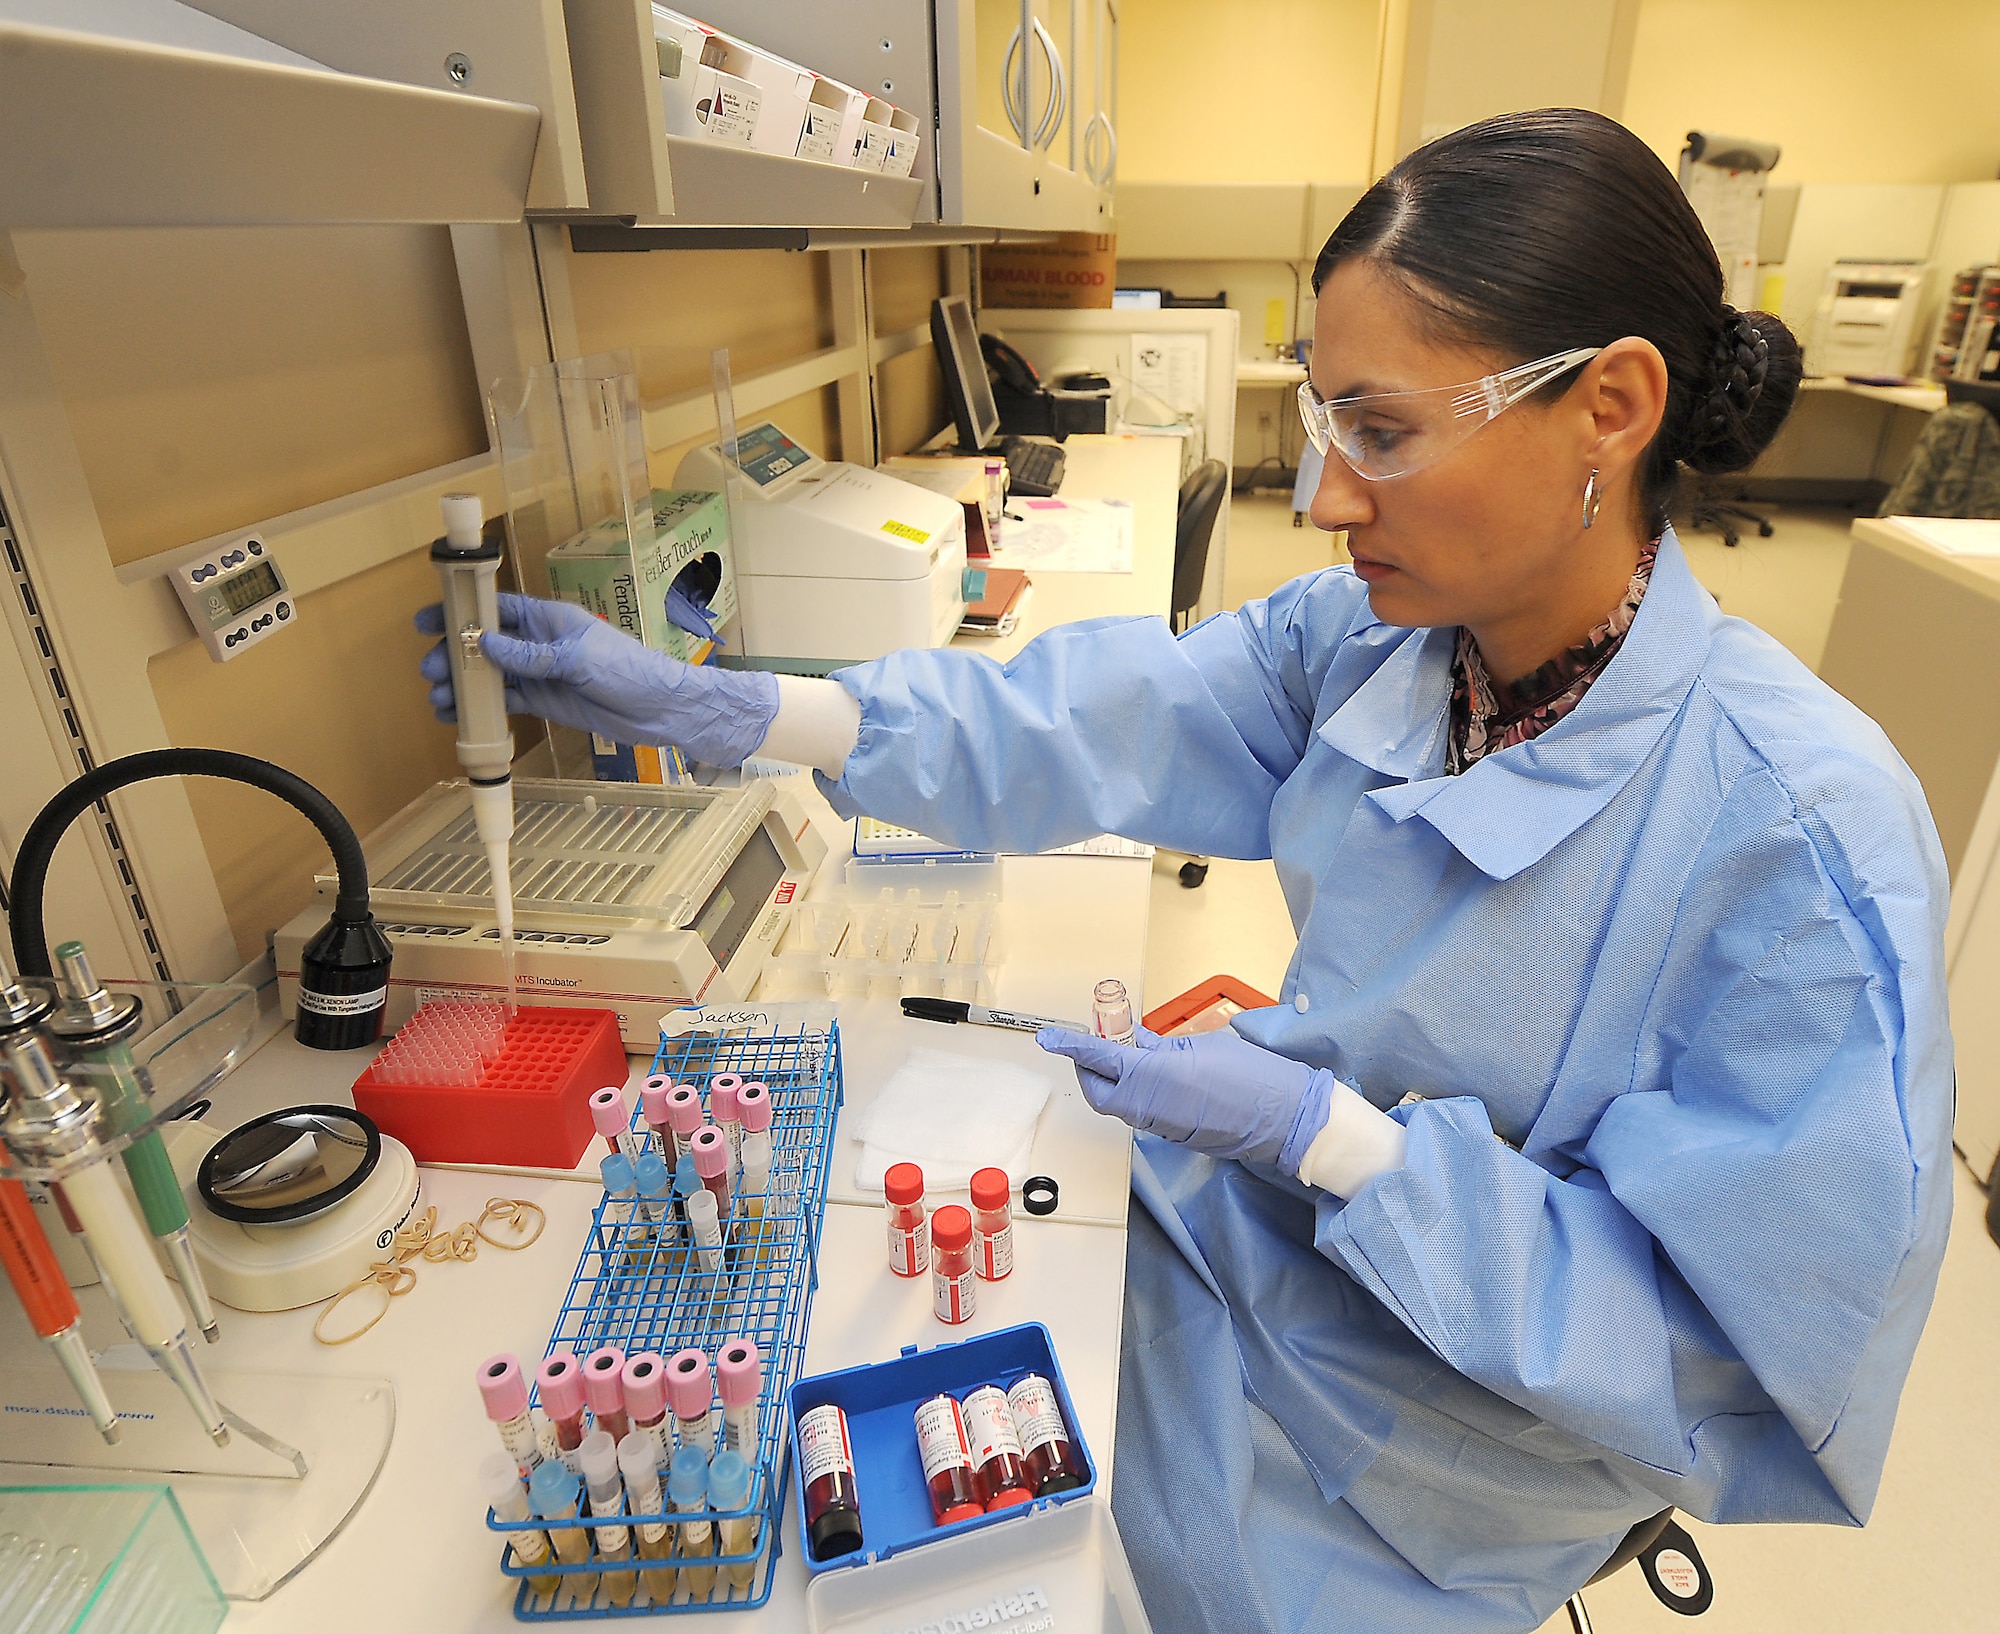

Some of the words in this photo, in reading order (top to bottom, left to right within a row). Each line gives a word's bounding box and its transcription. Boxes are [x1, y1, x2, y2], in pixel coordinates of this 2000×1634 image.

[1044, 270, 1106, 286] BLOOD
[673, 528, 703, 563] Touch
[613, 573, 634, 631] Tender
[515, 975, 535, 984] MTS
[344, 998, 360, 1006] LAMP
[687, 1010, 769, 1026] Jackson
[987, 1013, 1020, 1027] Sharpie
